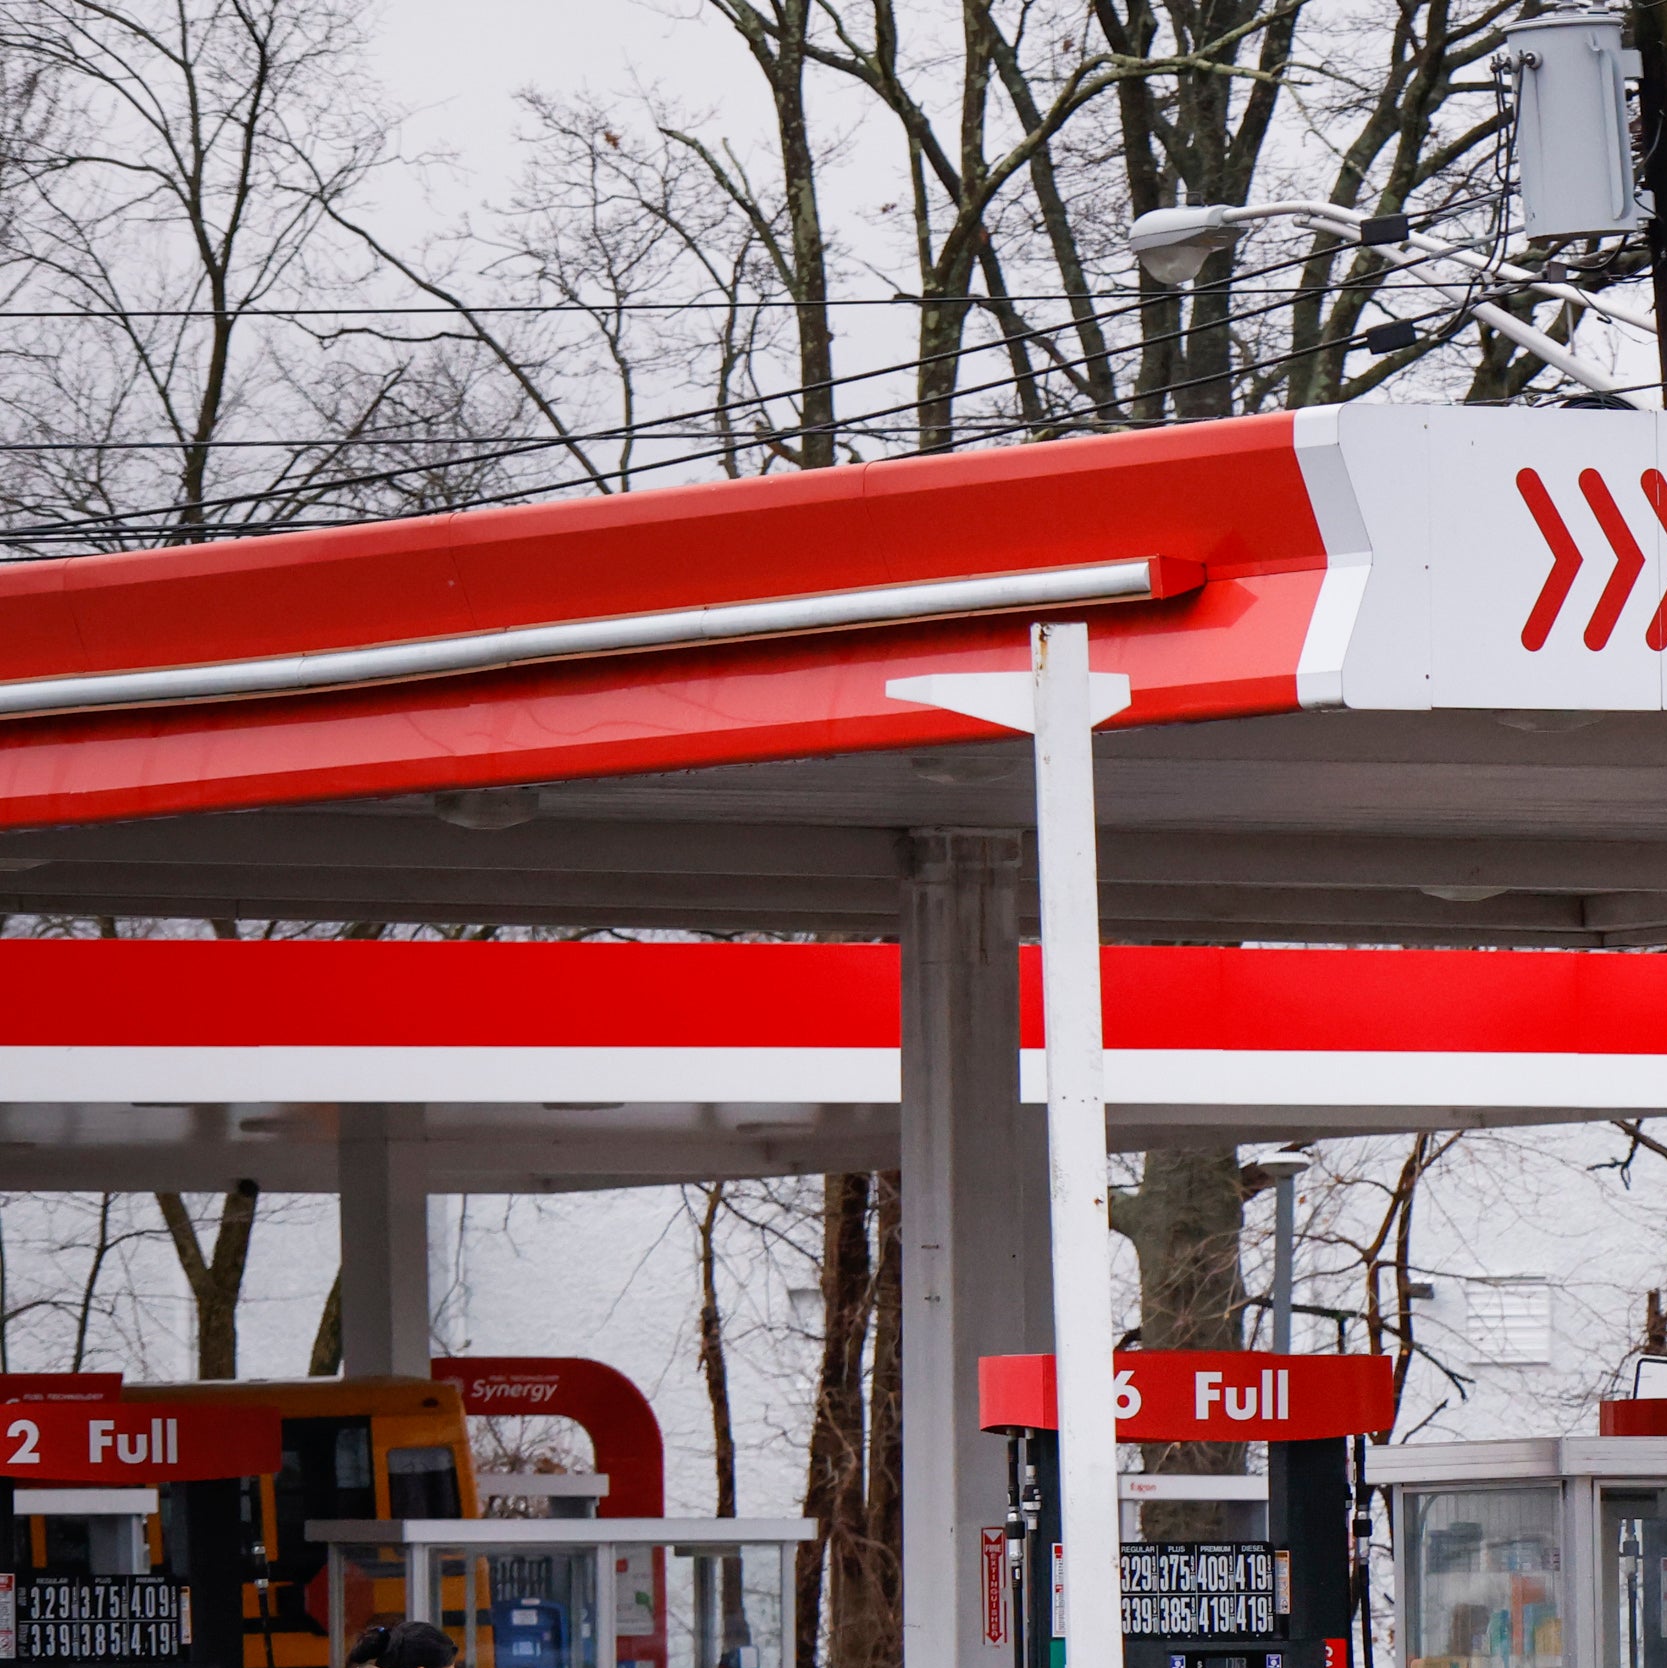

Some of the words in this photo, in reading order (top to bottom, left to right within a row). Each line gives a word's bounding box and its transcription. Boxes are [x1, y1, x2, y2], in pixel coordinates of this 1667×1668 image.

[471, 1378, 558, 1402] Synergy
[1114, 1370, 1142, 1420] 6
[1194, 1369, 1289, 1421] Full
[6, 1418, 41, 1464] 2
[88, 1417, 179, 1464] Full
[1121, 1545, 1156, 1553] REGULAR
[1167, 1545, 1186, 1553] PLUS
[1200, 1545, 1232, 1553] PREMIUM
[1241, 1544, 1266, 1552] DIESEL
[30, 1586, 70, 1620] 3.29
[80, 1585, 121, 1619] 3.75
[130, 1584, 171, 1618] 4.09
[31, 1623, 71, 1657] 3.39
[81, 1622, 122, 1657] 3.85
[130, 1622, 171, 1657] 4.19
